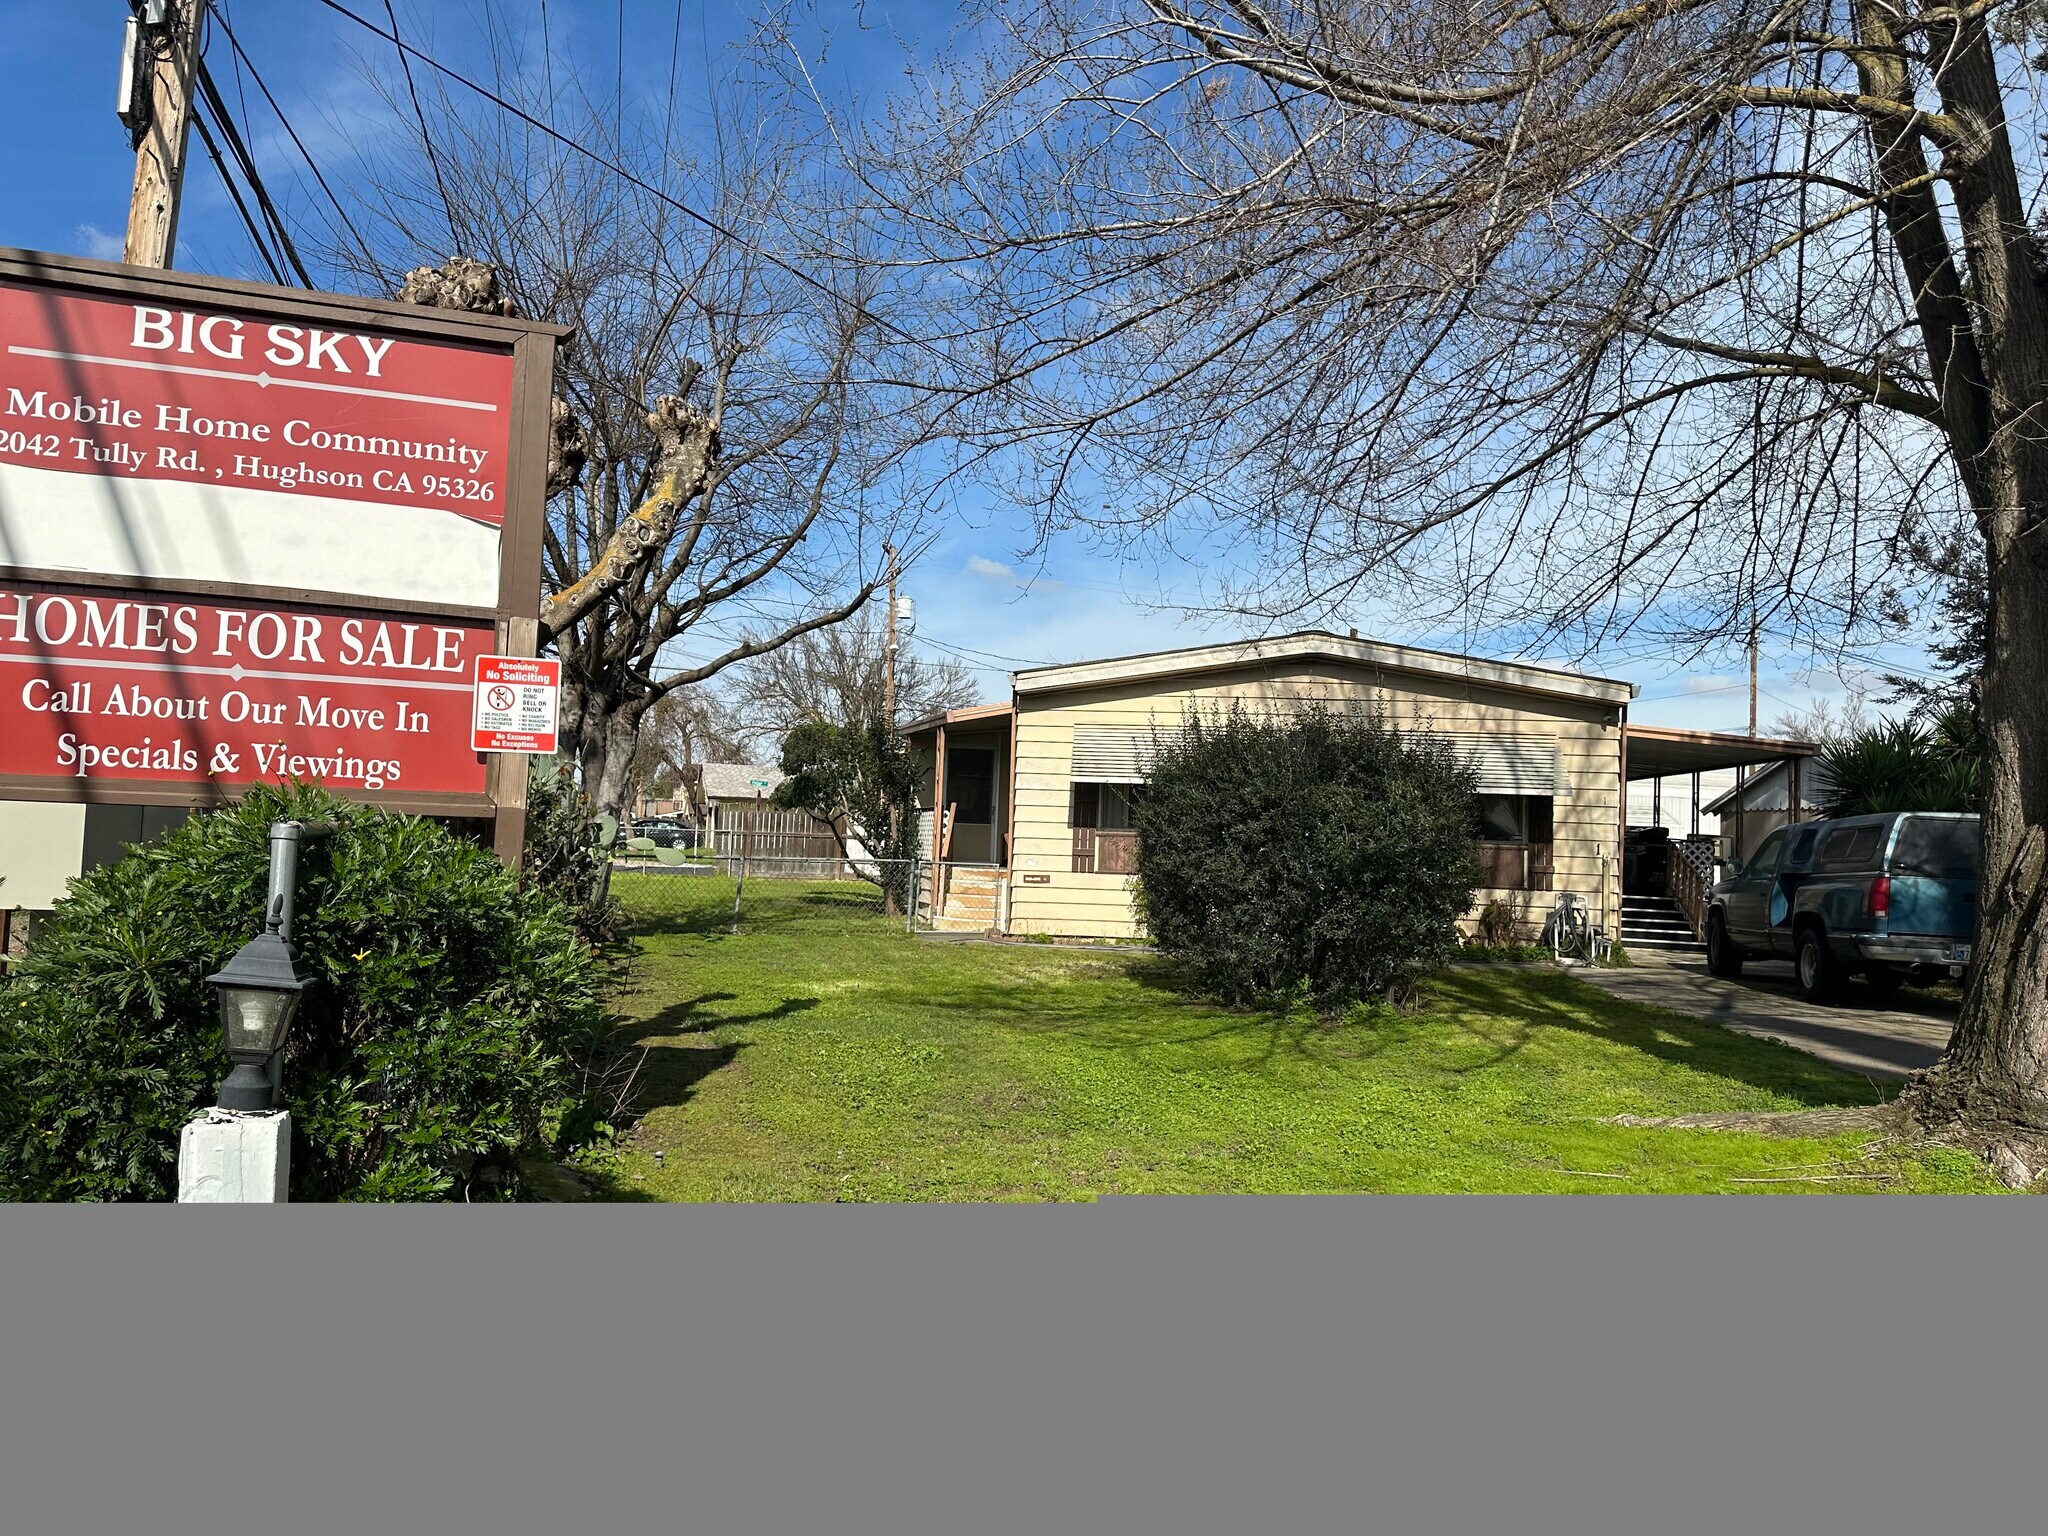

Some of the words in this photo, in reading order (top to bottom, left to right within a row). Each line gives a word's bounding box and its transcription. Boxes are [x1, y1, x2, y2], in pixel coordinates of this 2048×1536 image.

[131, 305, 245, 360] BIG
[264, 324, 396, 377] SKY
[4, 387, 142, 428] Mobile
[154, 404, 271, 443] Home
[283, 420, 489, 473] Community
[0, 429, 60, 457] 2042
[69, 436, 148, 472] Tully
[156, 447, 206, 473] Rd.
[233, 455, 364, 489] Hughson
[373, 470, 415, 494] CA
[423, 475, 495, 502] 95326
[0, 593, 198, 654] HOMES
[212, 609, 326, 663] FOR
[339, 618, 465, 673] SALE
[486, 670, 500, 680] No
[503, 671, 550, 684] Soliciting
[498, 662, 539, 672] Absolutely
[22, 678, 92, 714] Call
[100, 684, 210, 720] About
[220, 690, 287, 725] Our
[295, 696, 385, 731] Move
[395, 702, 430, 733] In
[57, 732, 198, 777] Specials
[210, 742, 240, 773] &
[251, 743, 401, 790] Viewings
[502, 740, 538, 748] Exceptions
[507, 733, 534, 741] Excuses
